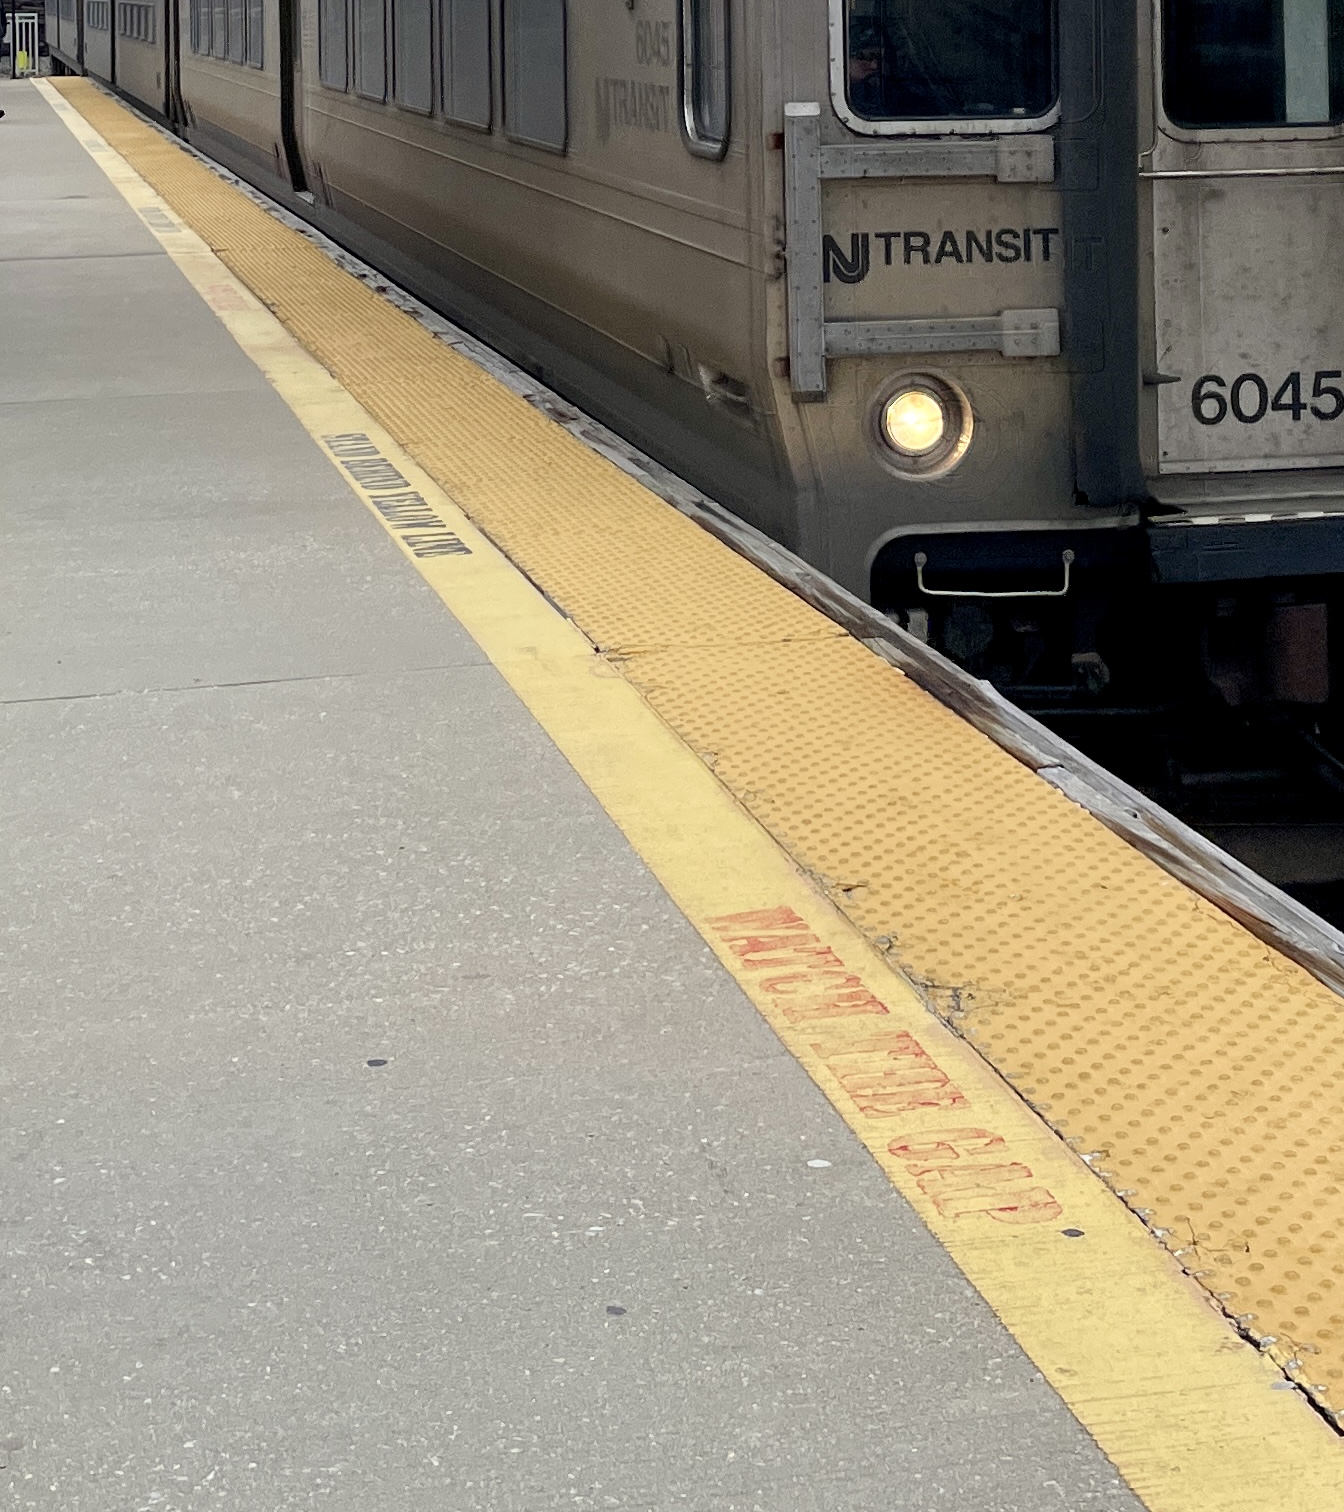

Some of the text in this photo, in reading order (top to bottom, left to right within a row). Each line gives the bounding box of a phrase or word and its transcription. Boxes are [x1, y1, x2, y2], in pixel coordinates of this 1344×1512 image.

[822, 227, 1059, 284] NJ TRANSIT
[886, 1126, 1064, 1225] GAP
